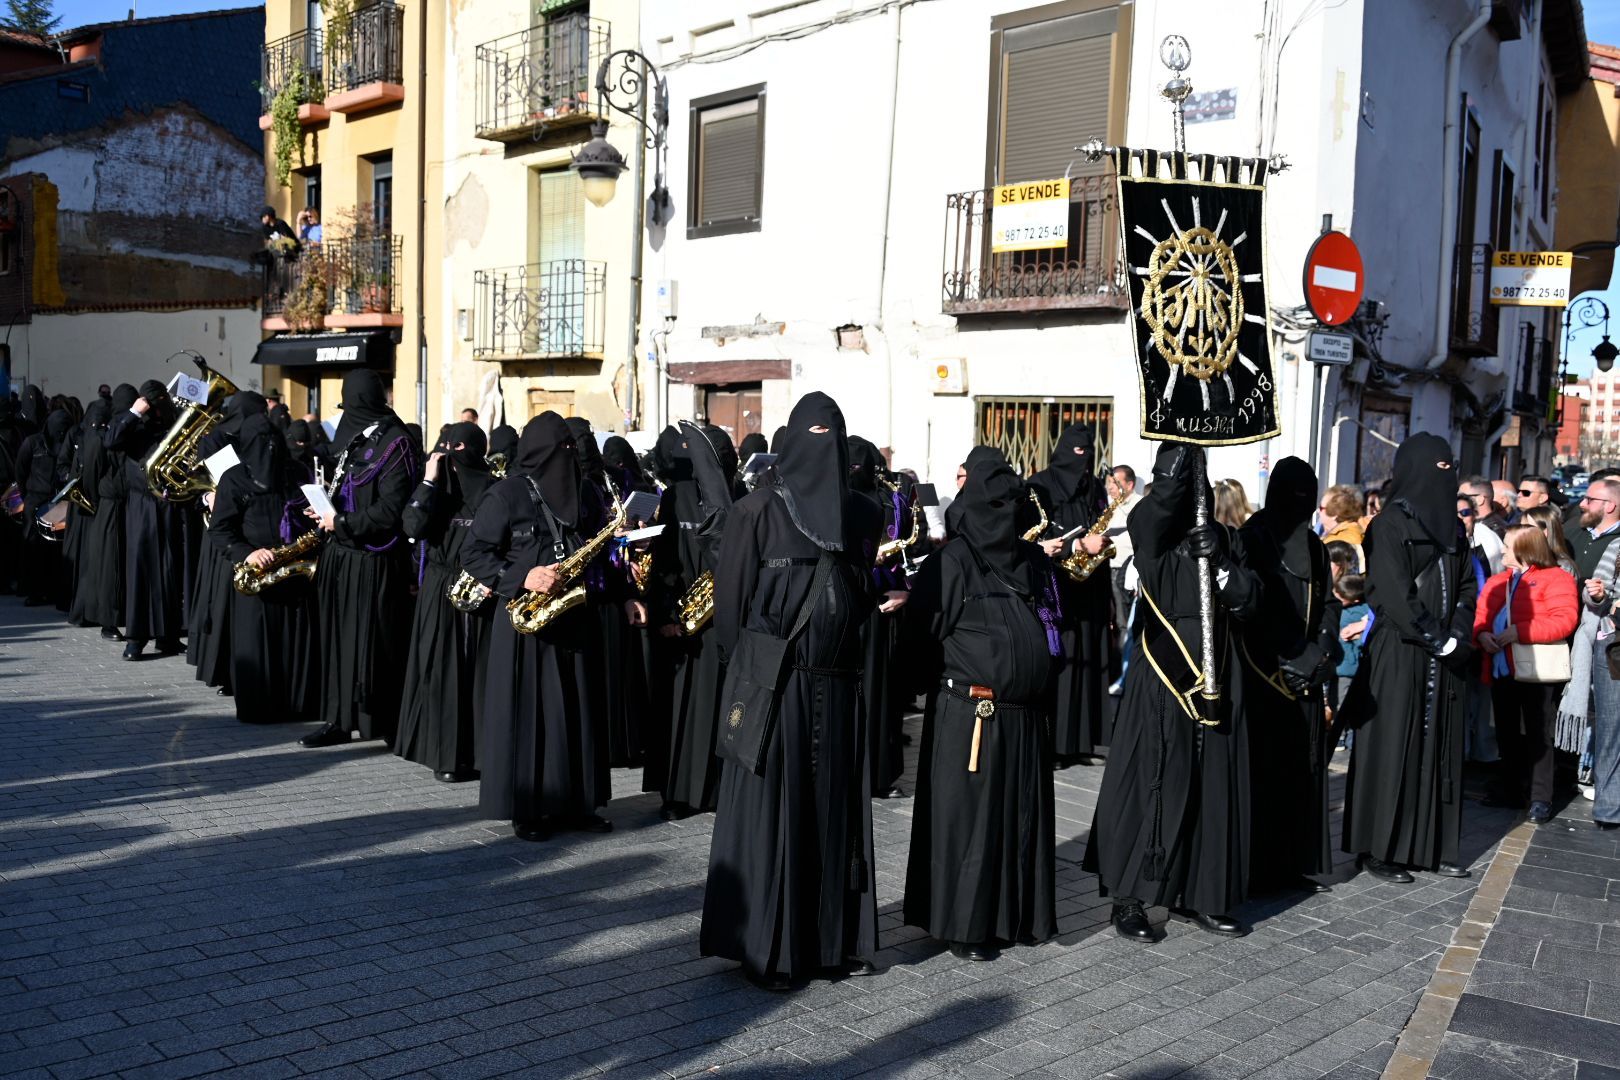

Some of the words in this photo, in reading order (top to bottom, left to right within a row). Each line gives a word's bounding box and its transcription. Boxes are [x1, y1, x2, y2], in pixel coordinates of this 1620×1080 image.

[1001, 188, 1015, 203] SE
[1020, 183, 1061, 200] VENDE
[1005, 229, 1020, 241] 987
[1024, 227, 1035, 239] 72
[1038, 226, 1049, 238] 25
[1053, 225, 1064, 237] 40
[1500, 253, 1516, 266] SE
[1520, 254, 1563, 266] VENDE
[1503, 286, 1520, 298] 987
[1524, 287, 1535, 298] 72
[1538, 288, 1550, 298] 25
[1553, 288, 1565, 298] 40
